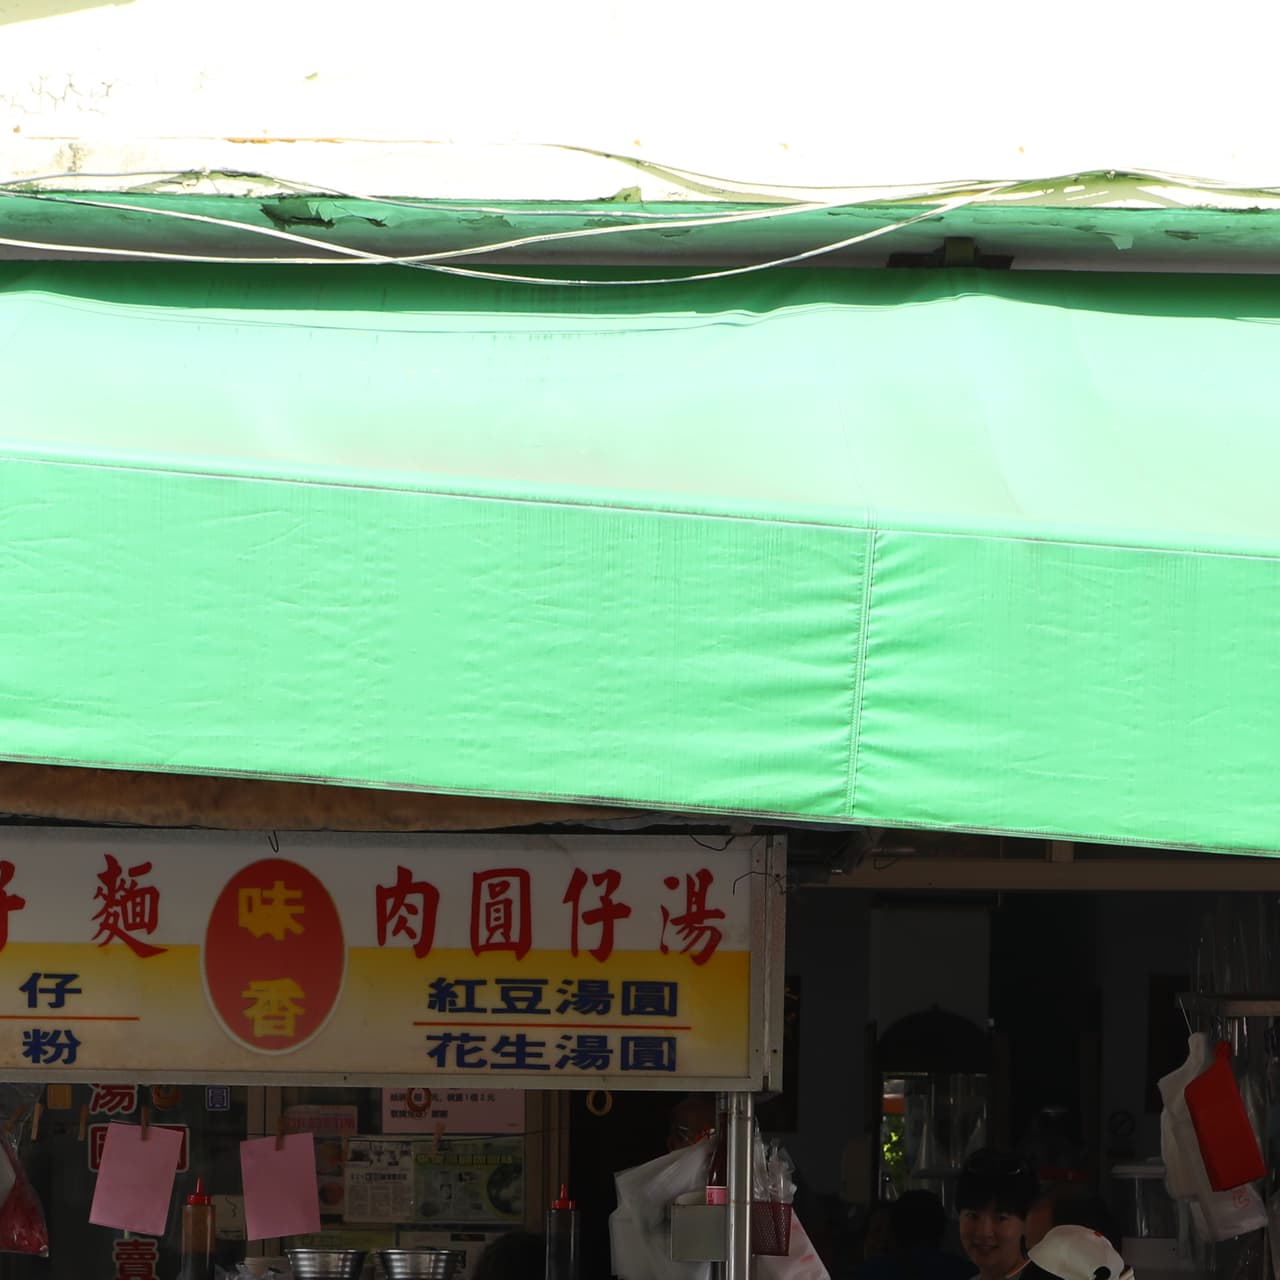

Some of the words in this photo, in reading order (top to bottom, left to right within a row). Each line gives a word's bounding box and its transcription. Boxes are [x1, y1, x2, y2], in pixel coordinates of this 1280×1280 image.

[376, 865, 725, 965] 肉圓仔湯
[238, 880, 305, 1038] 味香
[428, 977, 678, 1017] 紅豆湯圓
[427, 1033, 676, 1072] 花生湯圓
